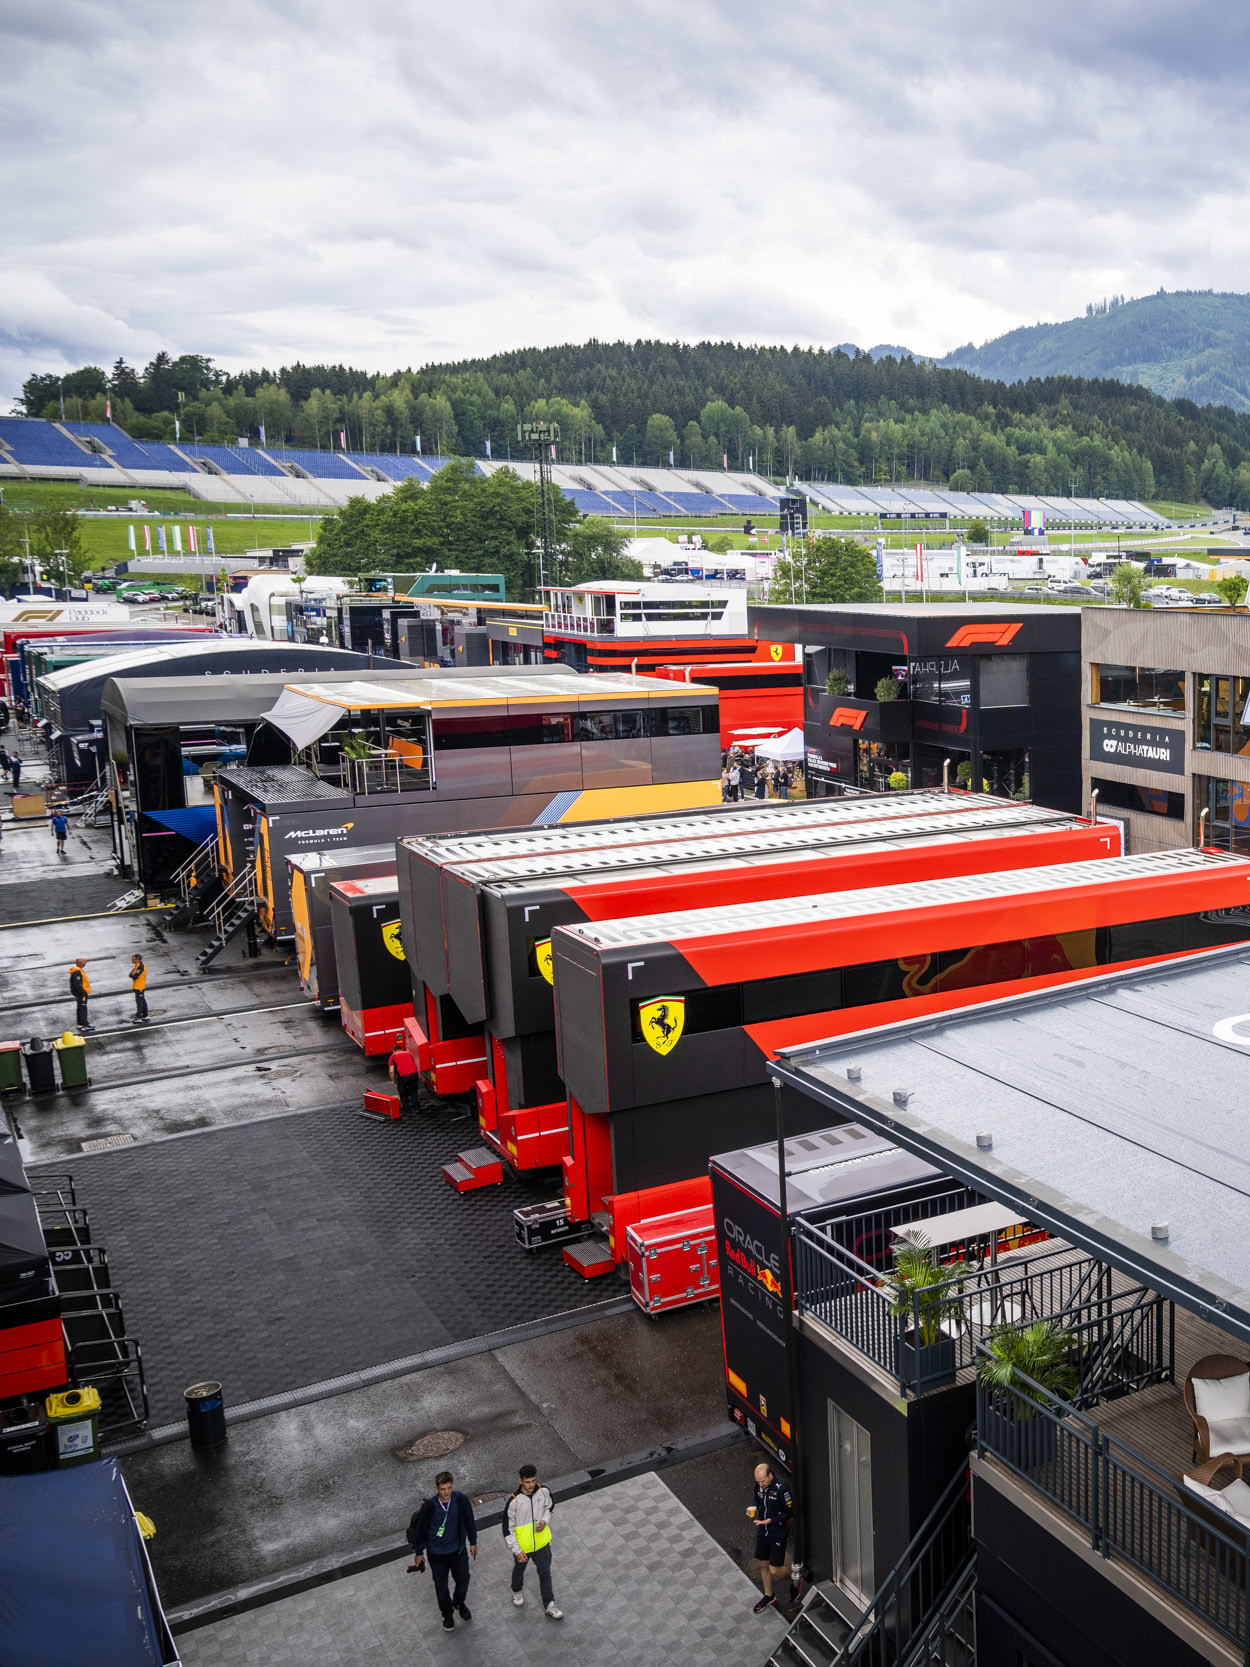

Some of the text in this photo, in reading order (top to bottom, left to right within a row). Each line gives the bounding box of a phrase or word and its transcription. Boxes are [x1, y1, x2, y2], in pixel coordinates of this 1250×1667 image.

[945, 622, 1024, 648] F1
[829, 707, 869, 731] F1
[1103, 727, 1170, 743] SCUDERIA
[1116, 741, 1170, 761] ALPHATAURI
[284, 827, 347, 839] McLaren
[555, 1218, 564, 1226] 15
[723, 1217, 780, 1275] ORACLE
[725, 1240, 756, 1277] Red Bull
[727, 1265, 784, 1319] RACING
